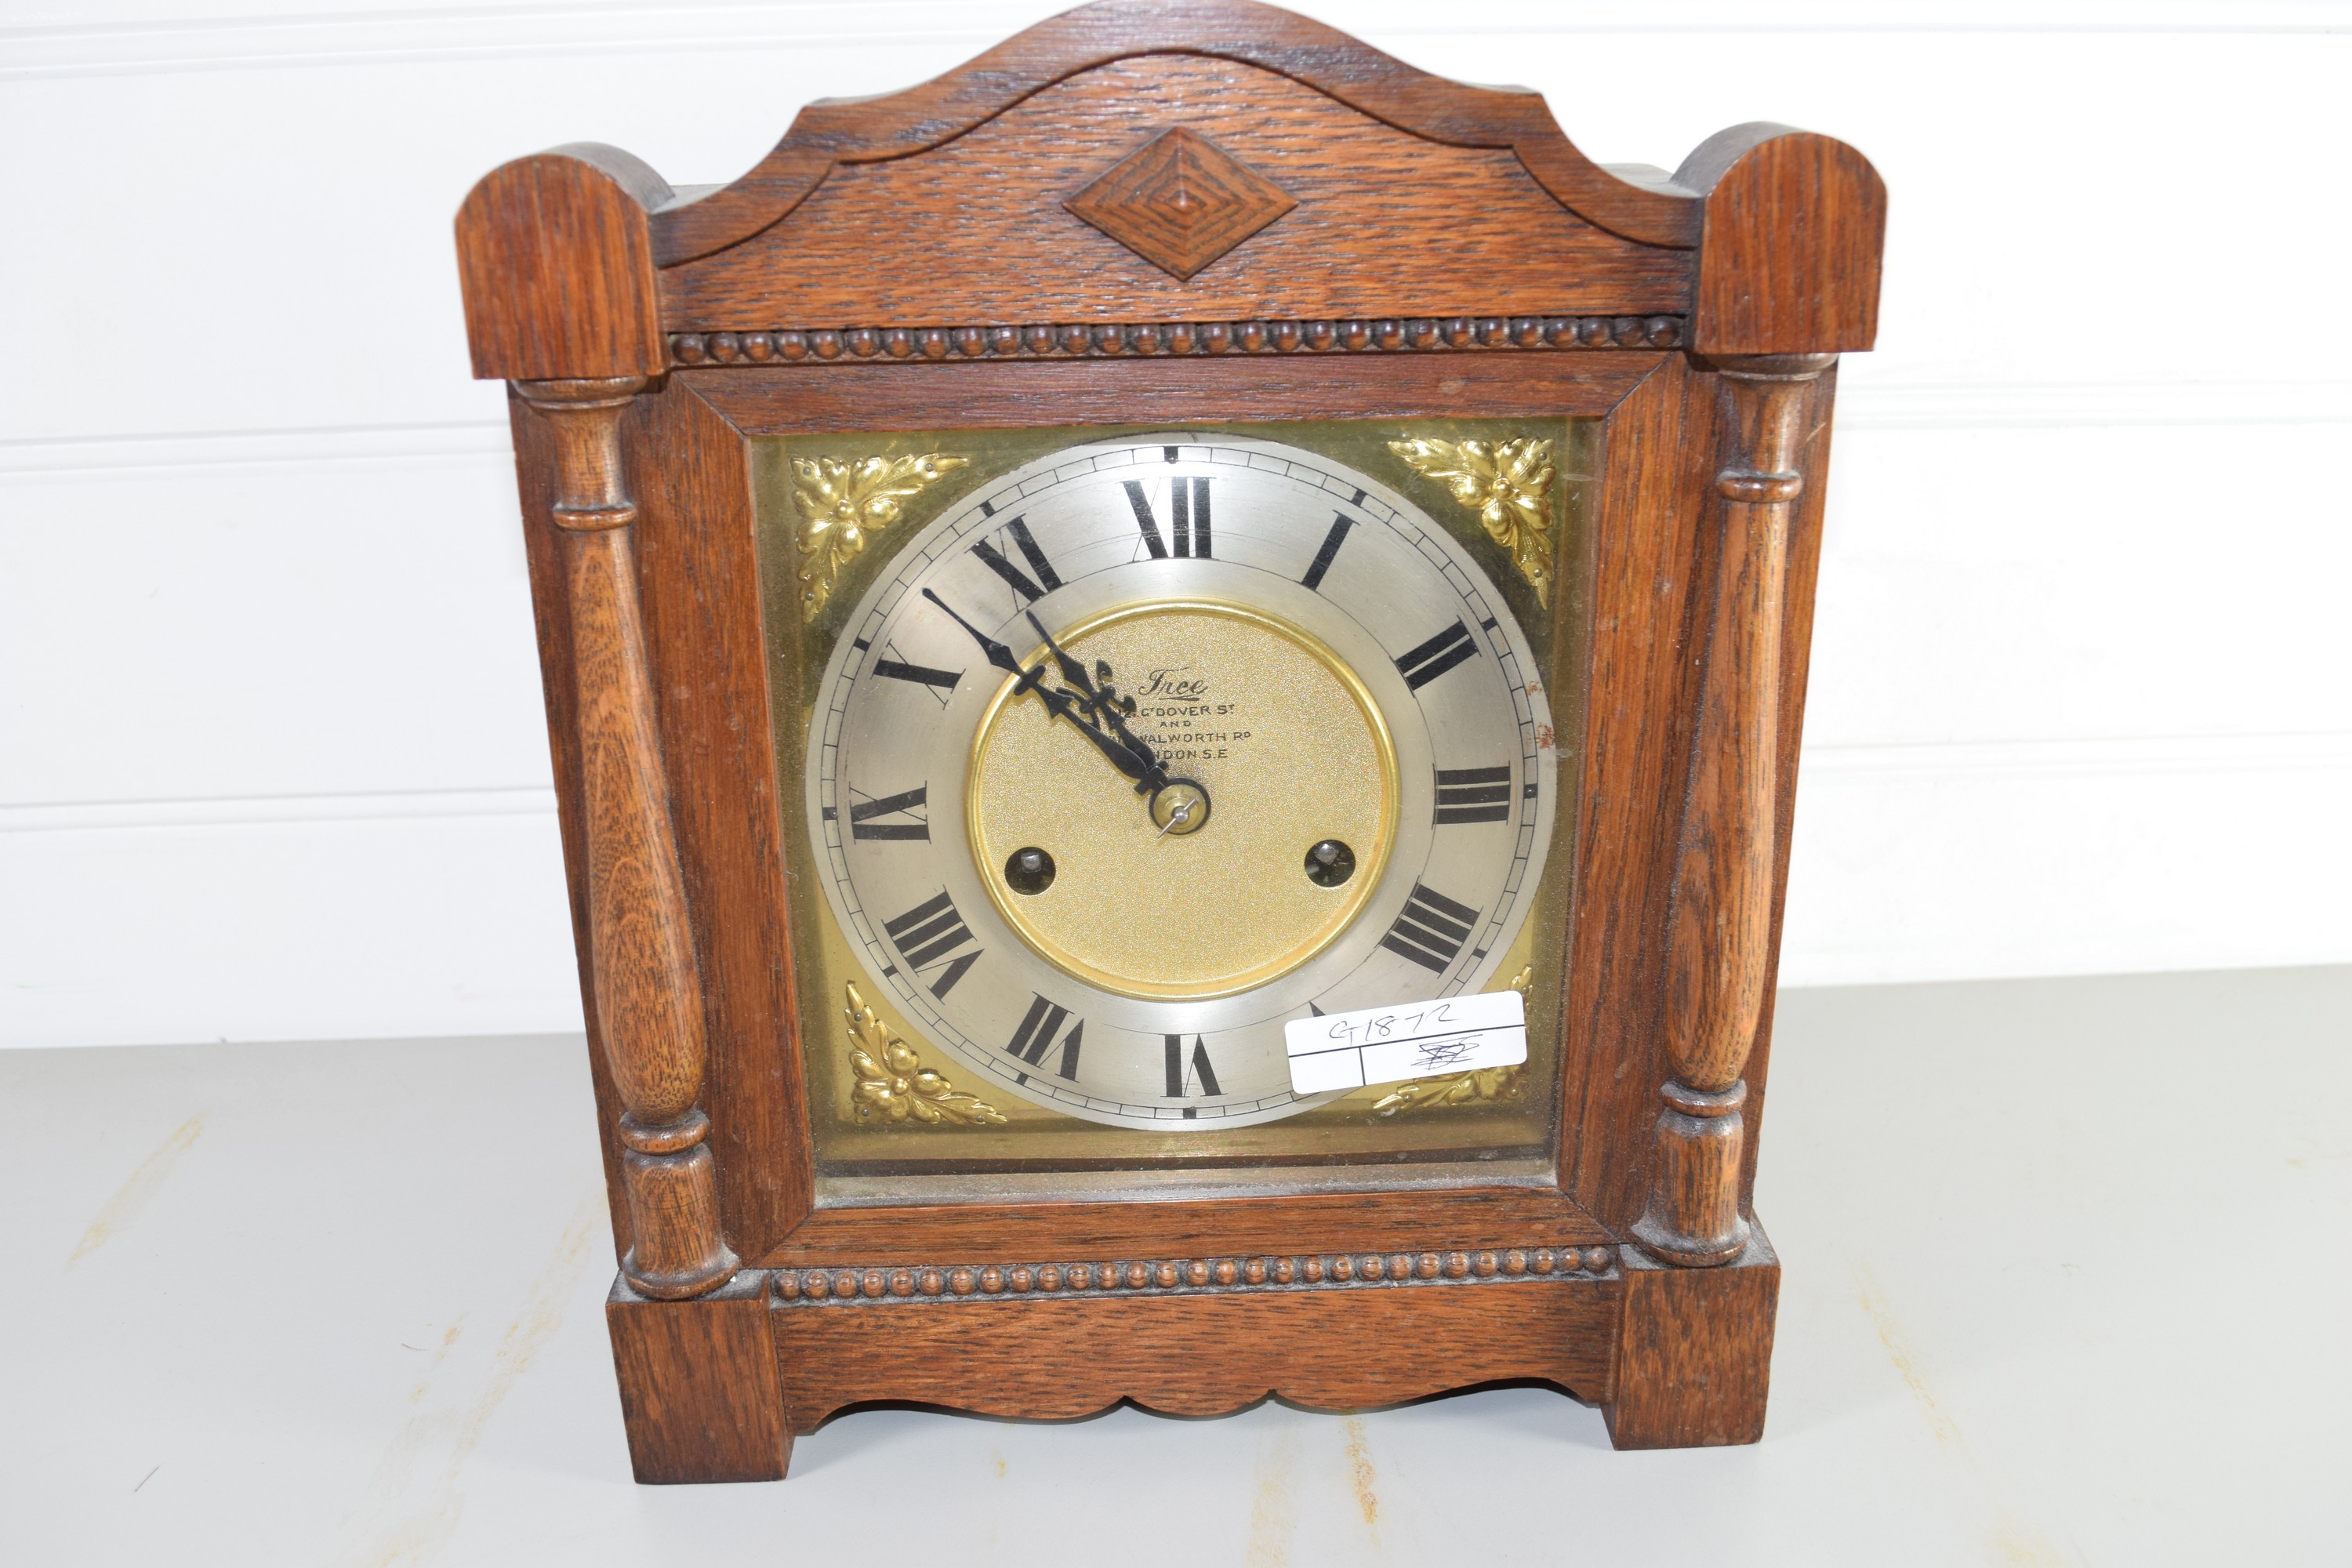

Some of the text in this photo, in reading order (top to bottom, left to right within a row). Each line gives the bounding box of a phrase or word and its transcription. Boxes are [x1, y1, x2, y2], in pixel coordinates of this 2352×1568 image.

[1123, 476, 1220, 561] XII
[1300, 510, 1362, 590] I
[967, 513, 1069, 612] XI
[873, 638, 967, 710] X
[1388, 615, 1483, 697] II
[1156, 706, 1211, 717] DOVER
[850, 781, 931, 844] IX
[1433, 766, 1512, 829] III
[882, 892, 985, 1004] VIII
[1374, 874, 1483, 978] IIII
[1001, 990, 1086, 1083] VII
[1160, 1033, 1226, 1098] VI
